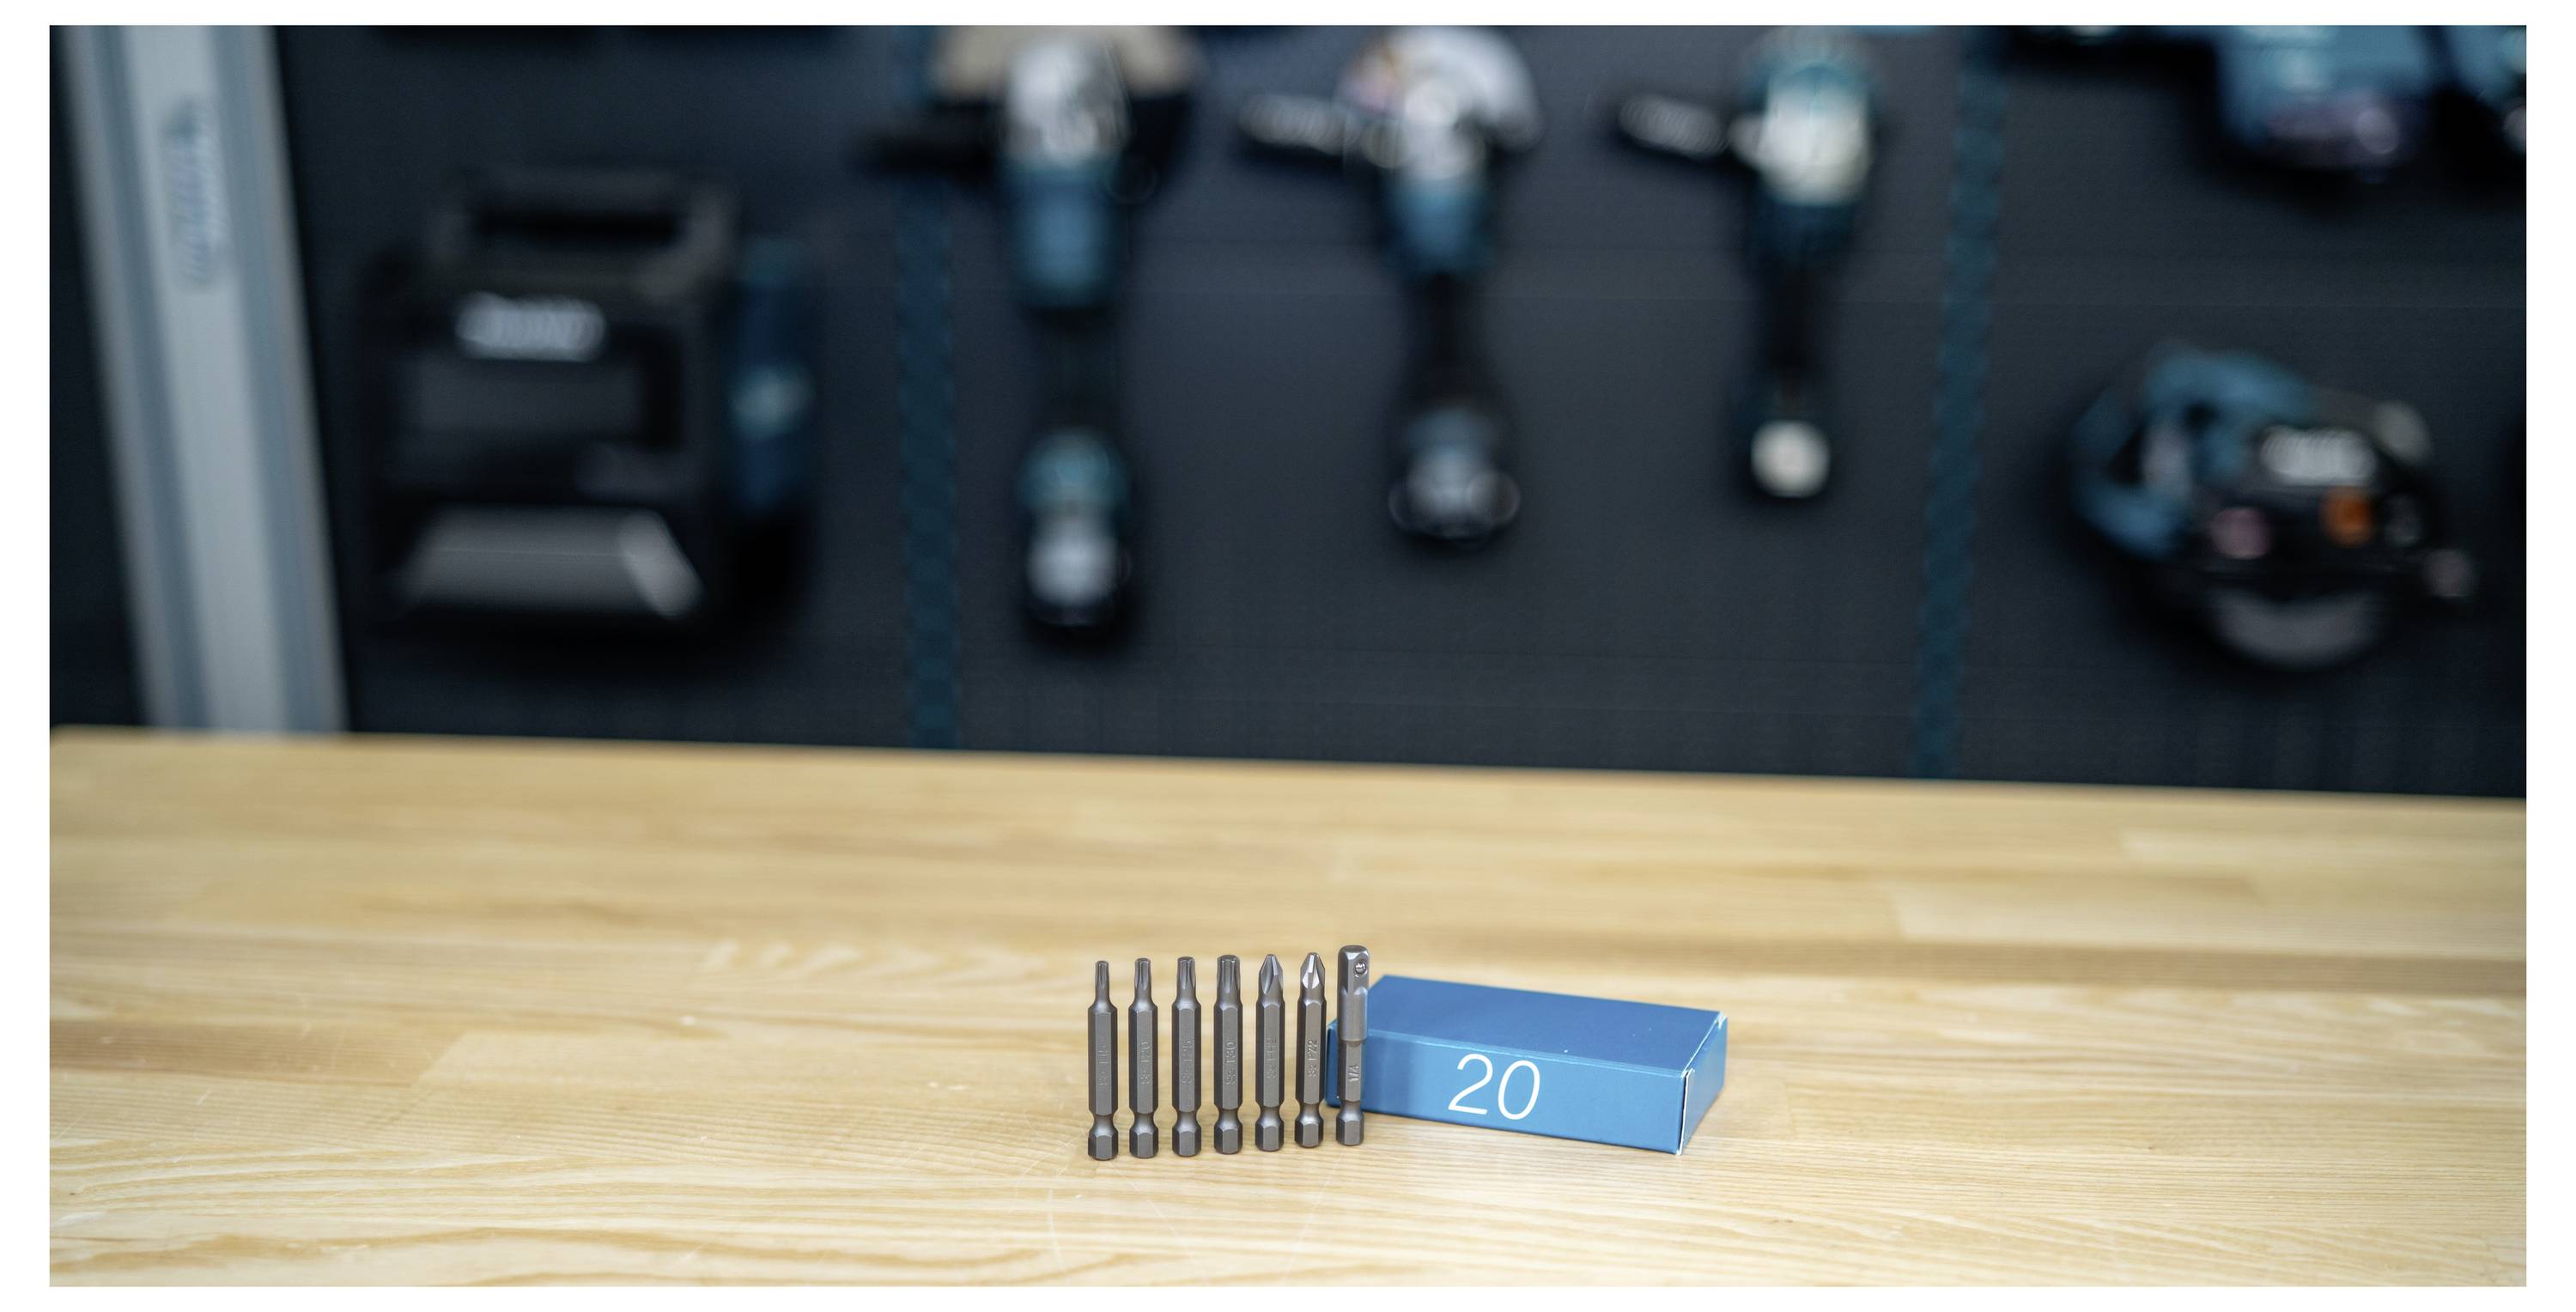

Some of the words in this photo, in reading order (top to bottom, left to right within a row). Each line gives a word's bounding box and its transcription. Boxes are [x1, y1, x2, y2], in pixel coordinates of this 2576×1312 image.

[1225, 1041, 1236, 1064] T30
[1266, 1036, 1277, 1061] PH2
[1307, 1039, 1318, 1061] PZ2
[1448, 1053, 1540, 1120] 20
